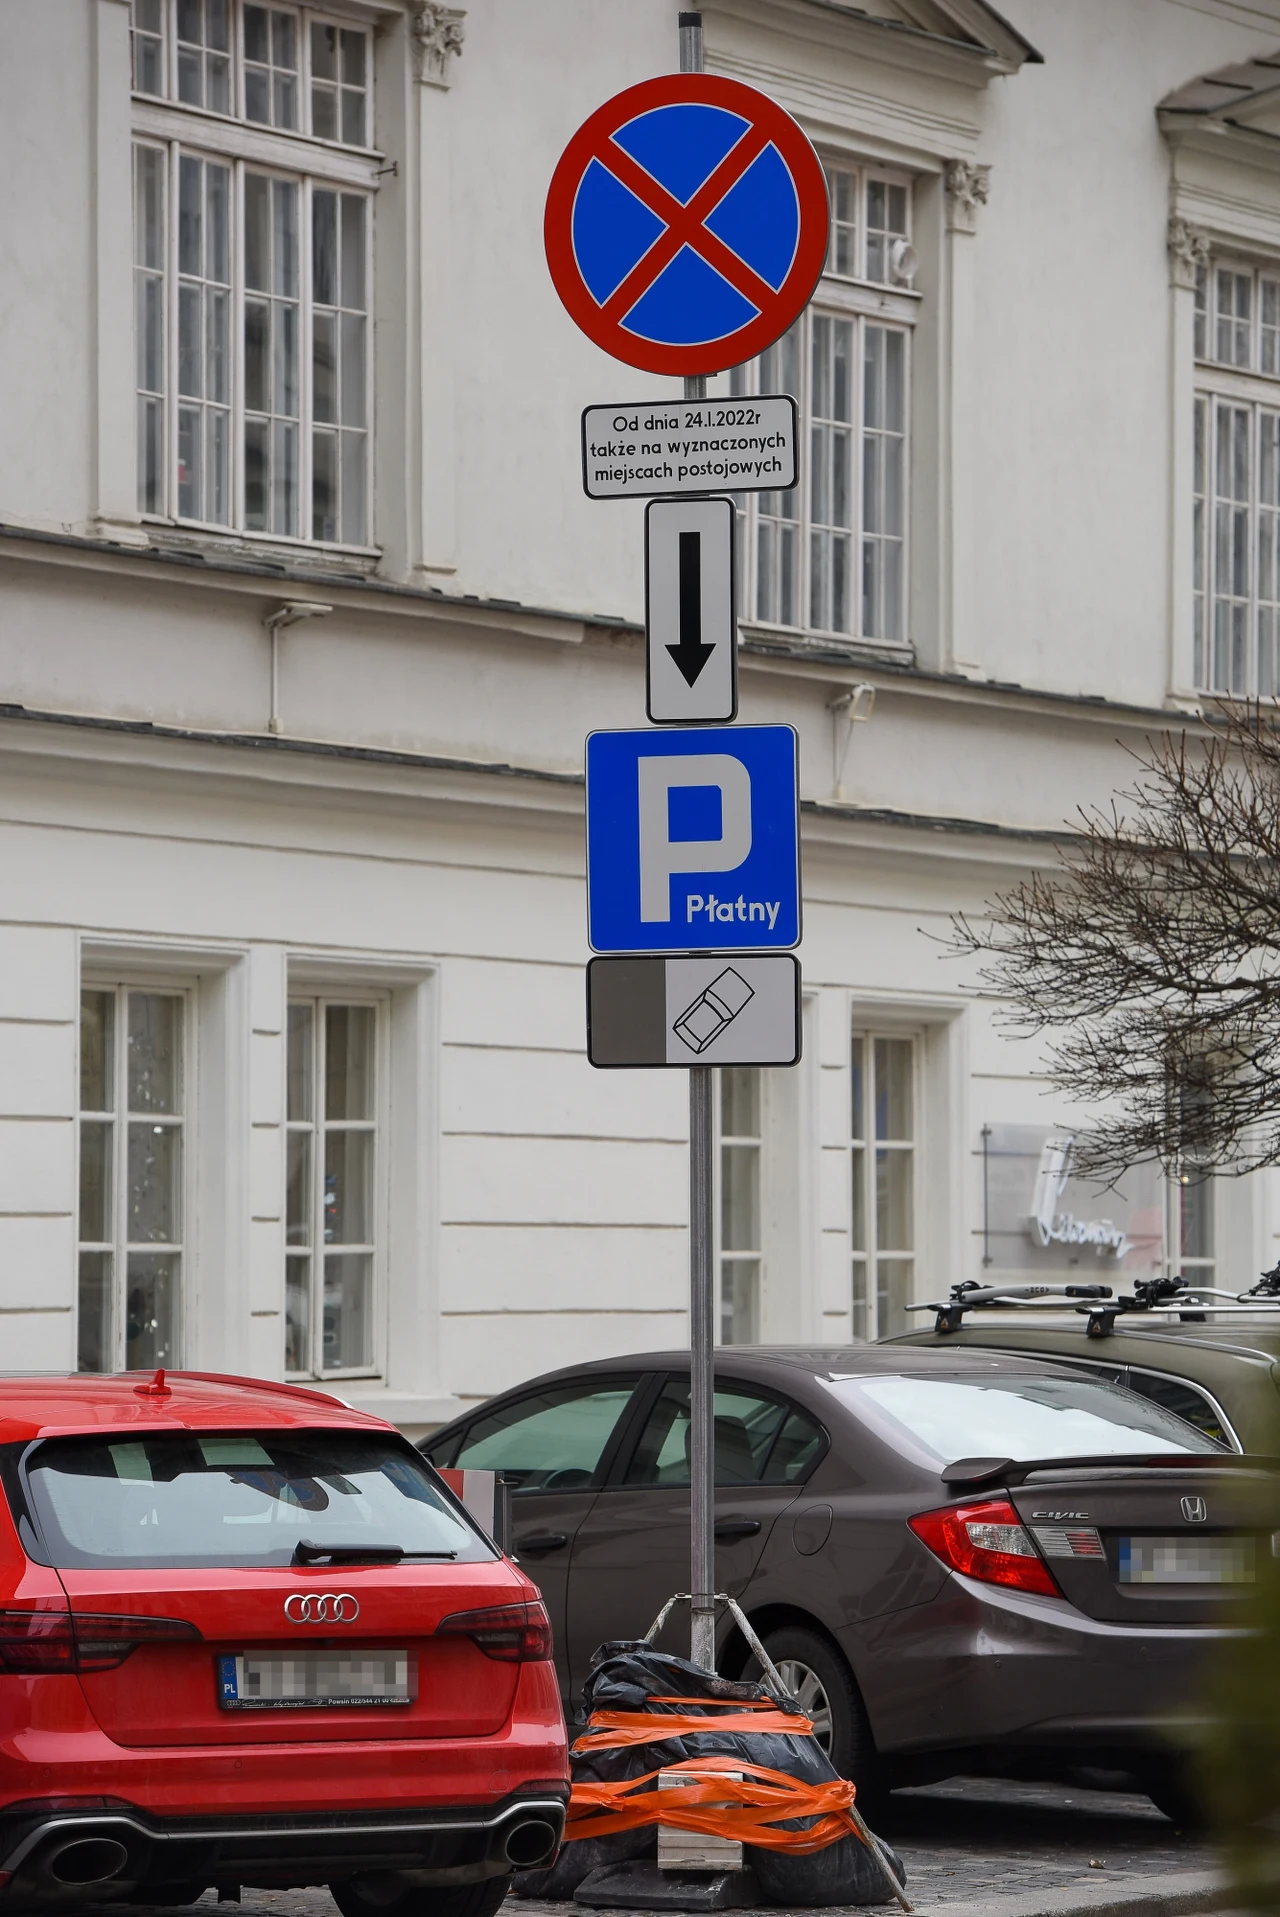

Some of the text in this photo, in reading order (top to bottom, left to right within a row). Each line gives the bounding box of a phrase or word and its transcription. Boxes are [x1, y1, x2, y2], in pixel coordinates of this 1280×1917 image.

[612, 414, 639, 432] Od
[644, 413, 679, 431] dnia
[590, 432, 786, 457] także na wyznaczonych
[595, 456, 782, 484] miejscach postojowych
[637, 753, 752, 923] P
[687, 894, 781, 930] Płatny
[1032, 1511, 1090, 1520] CIVIC
[223, 1683, 237, 1694] PL
